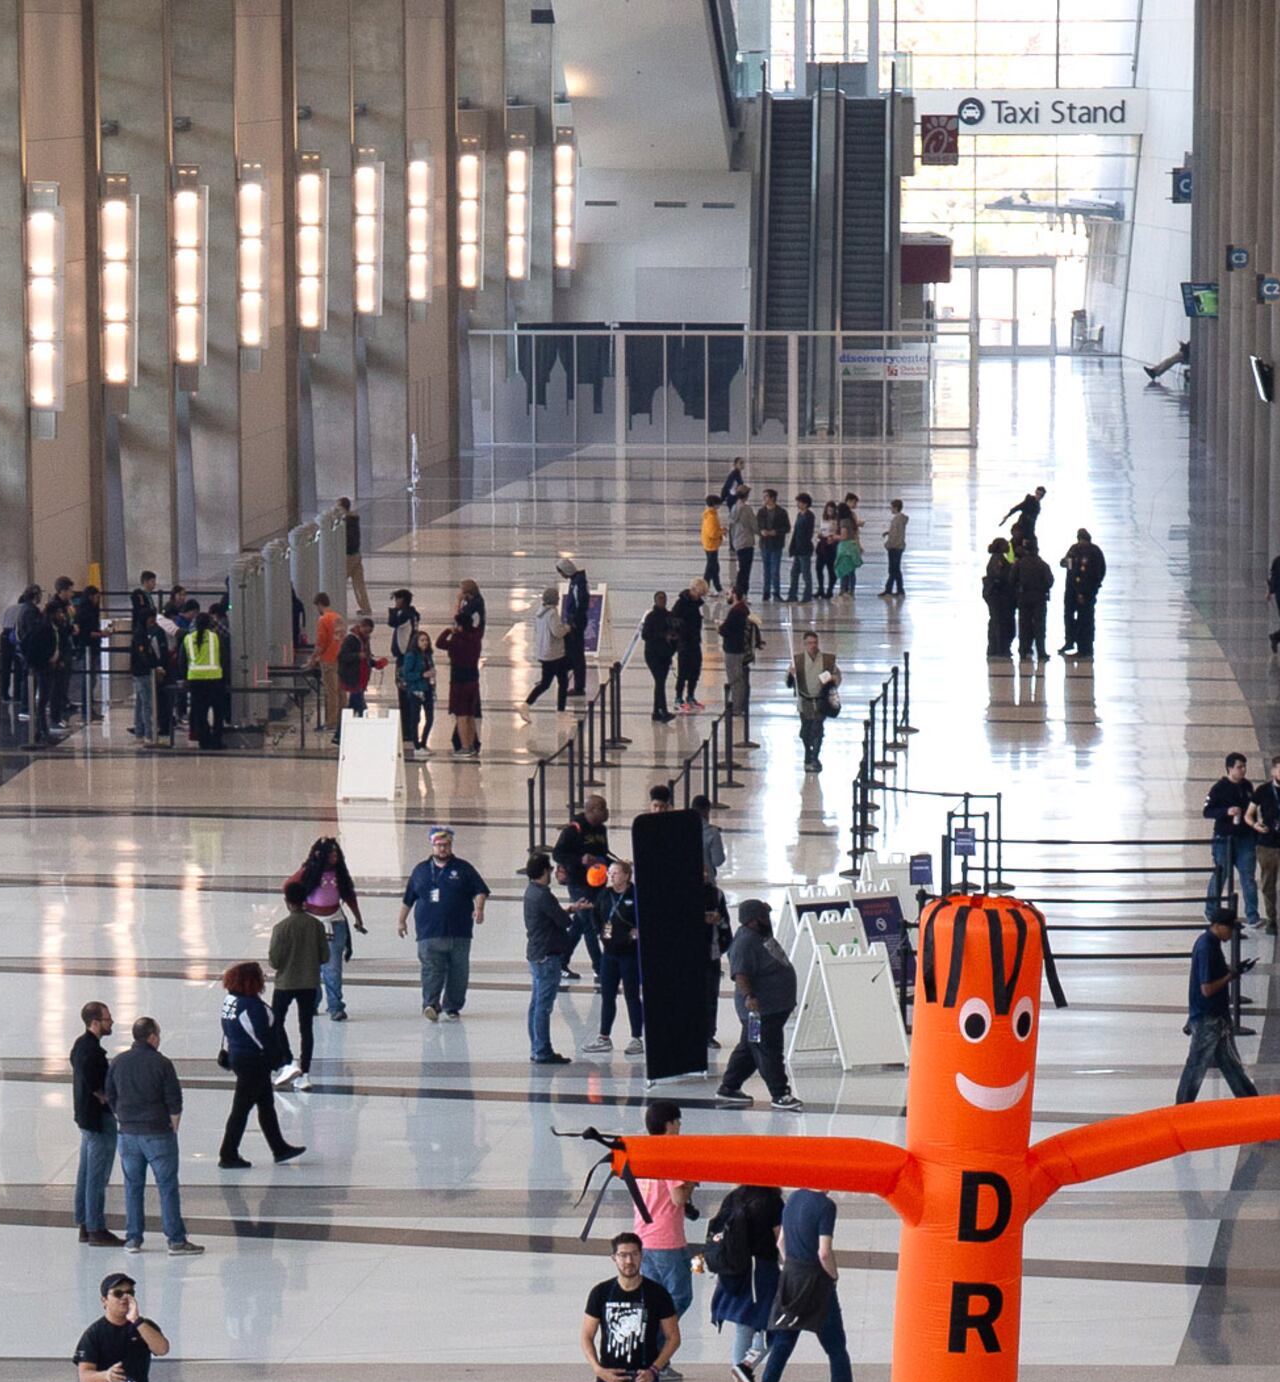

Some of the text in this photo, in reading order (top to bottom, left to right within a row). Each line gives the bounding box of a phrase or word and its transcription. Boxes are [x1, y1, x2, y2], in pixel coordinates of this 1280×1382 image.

[991, 100, 1126, 124] Taxi Stand
[1179, 179, 1192, 193] C
[1231, 253, 1247, 264] C3
[1263, 284, 1280, 295] C2
